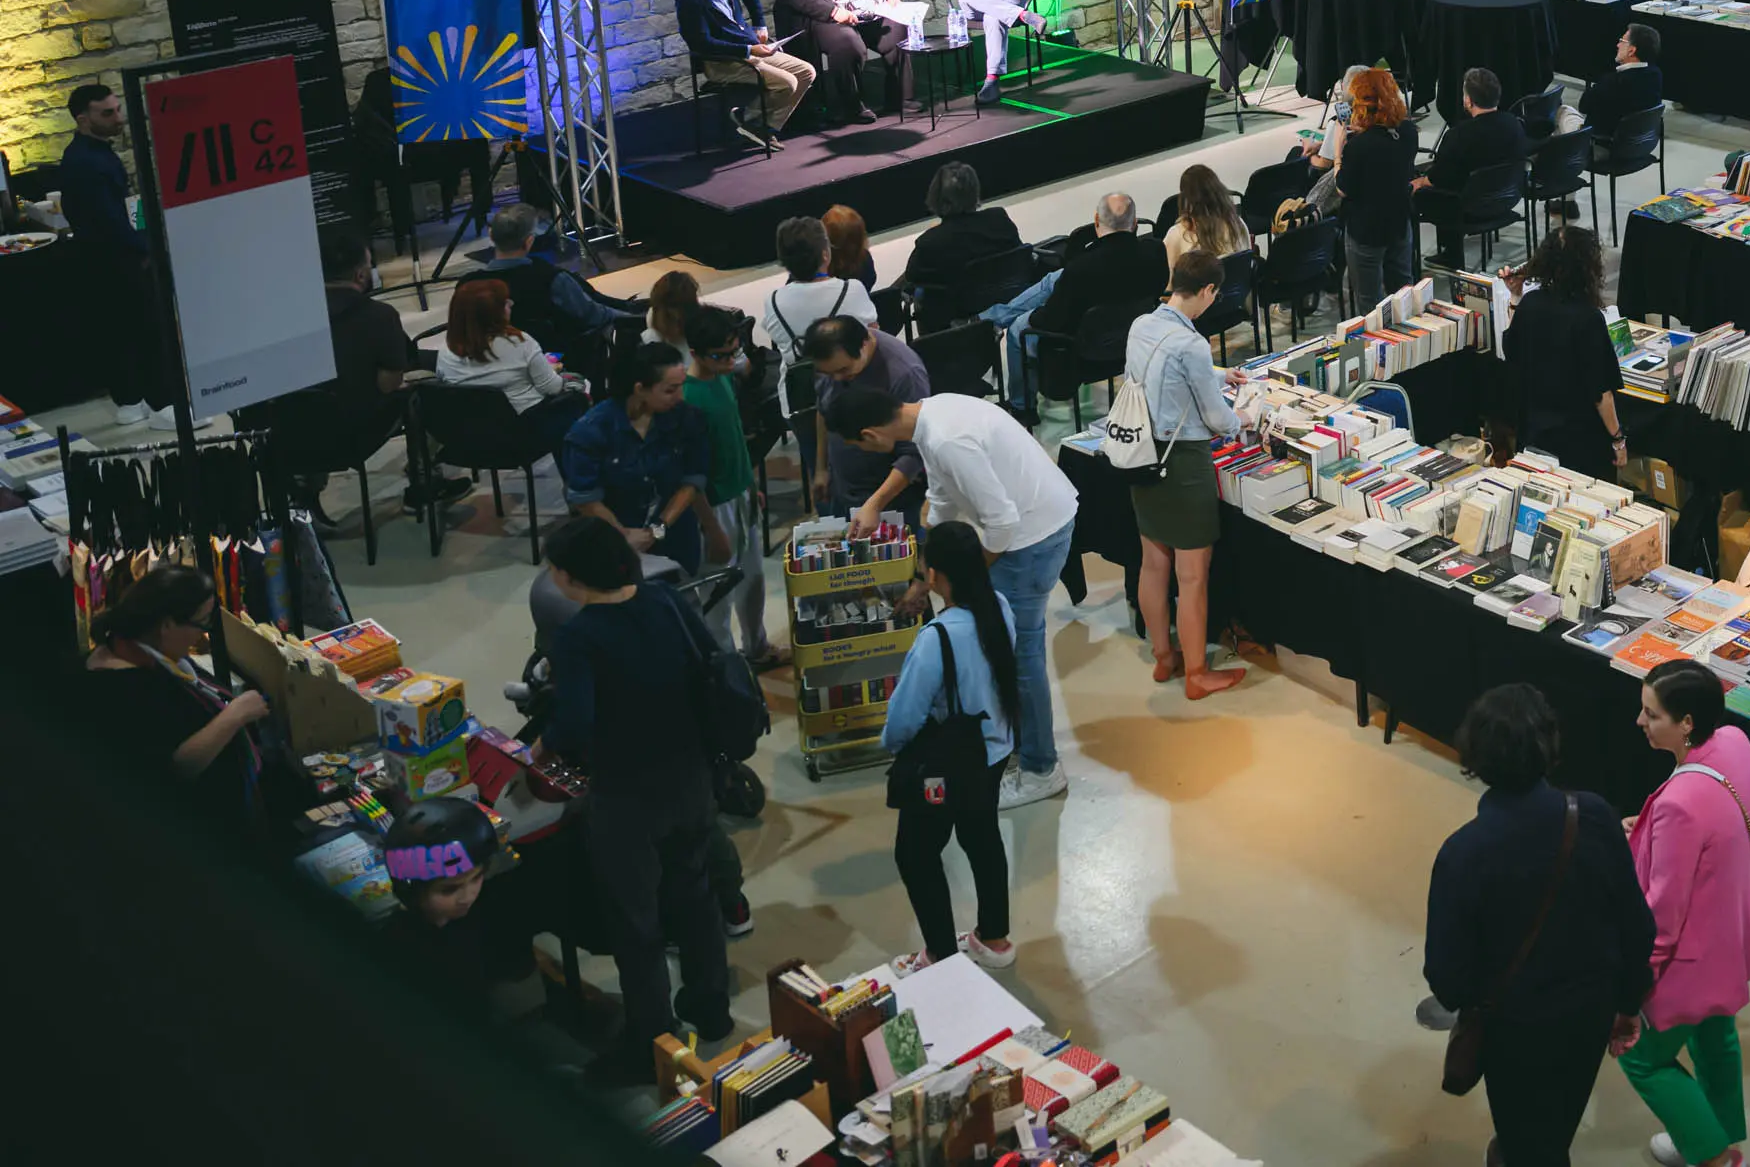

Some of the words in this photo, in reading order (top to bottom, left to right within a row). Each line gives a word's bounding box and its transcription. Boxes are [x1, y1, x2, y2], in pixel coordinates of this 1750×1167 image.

[249, 119, 275, 145] C
[253, 145, 296, 174] 42
[200, 377, 248, 397] Brainfood
[846, 569, 871, 577] FOOD
[823, 644, 852, 654] BOOKS
[843, 649, 871, 658] hungry
